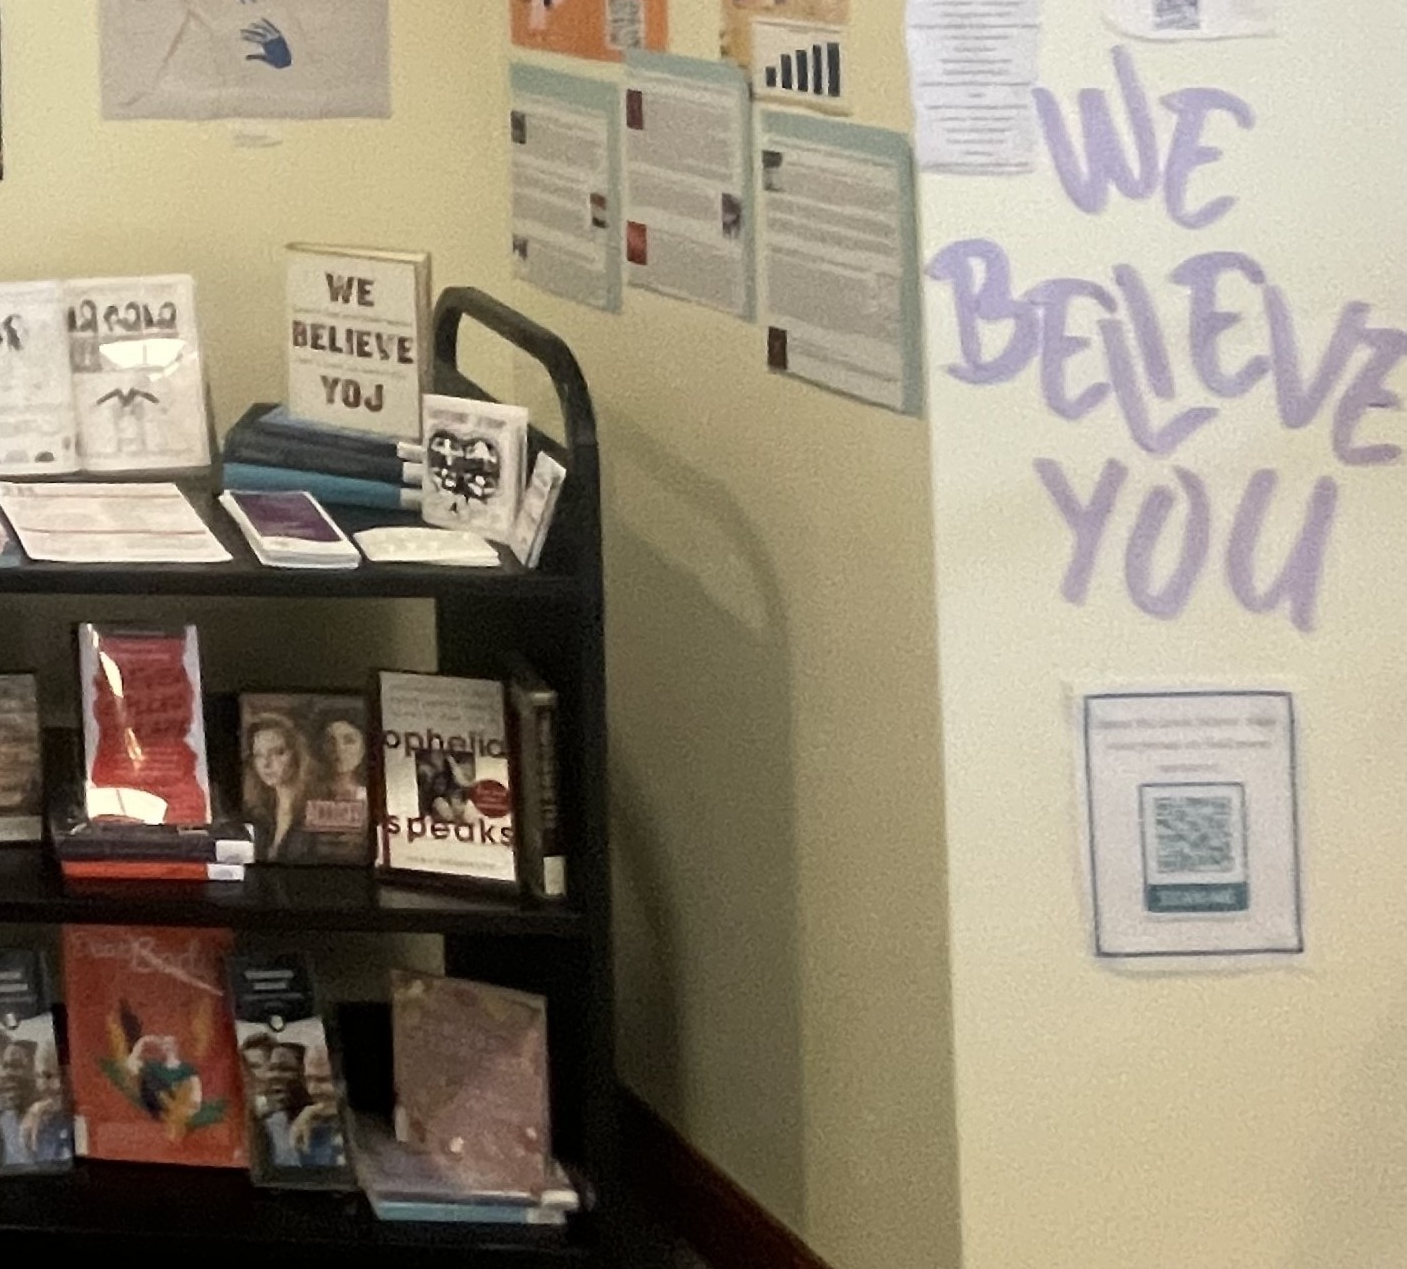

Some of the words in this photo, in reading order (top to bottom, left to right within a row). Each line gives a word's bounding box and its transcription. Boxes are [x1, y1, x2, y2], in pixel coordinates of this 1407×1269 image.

[1030, 44, 1257, 229] WE
[324, 272, 375, 307] WE
[292, 319, 415, 365] BELIEVE
[924, 237, 1407, 467] BELIEVE
[1032, 456, 1339, 631] YOU
[383, 727, 505, 758] ophelia
[385, 814, 515, 846] speaks
